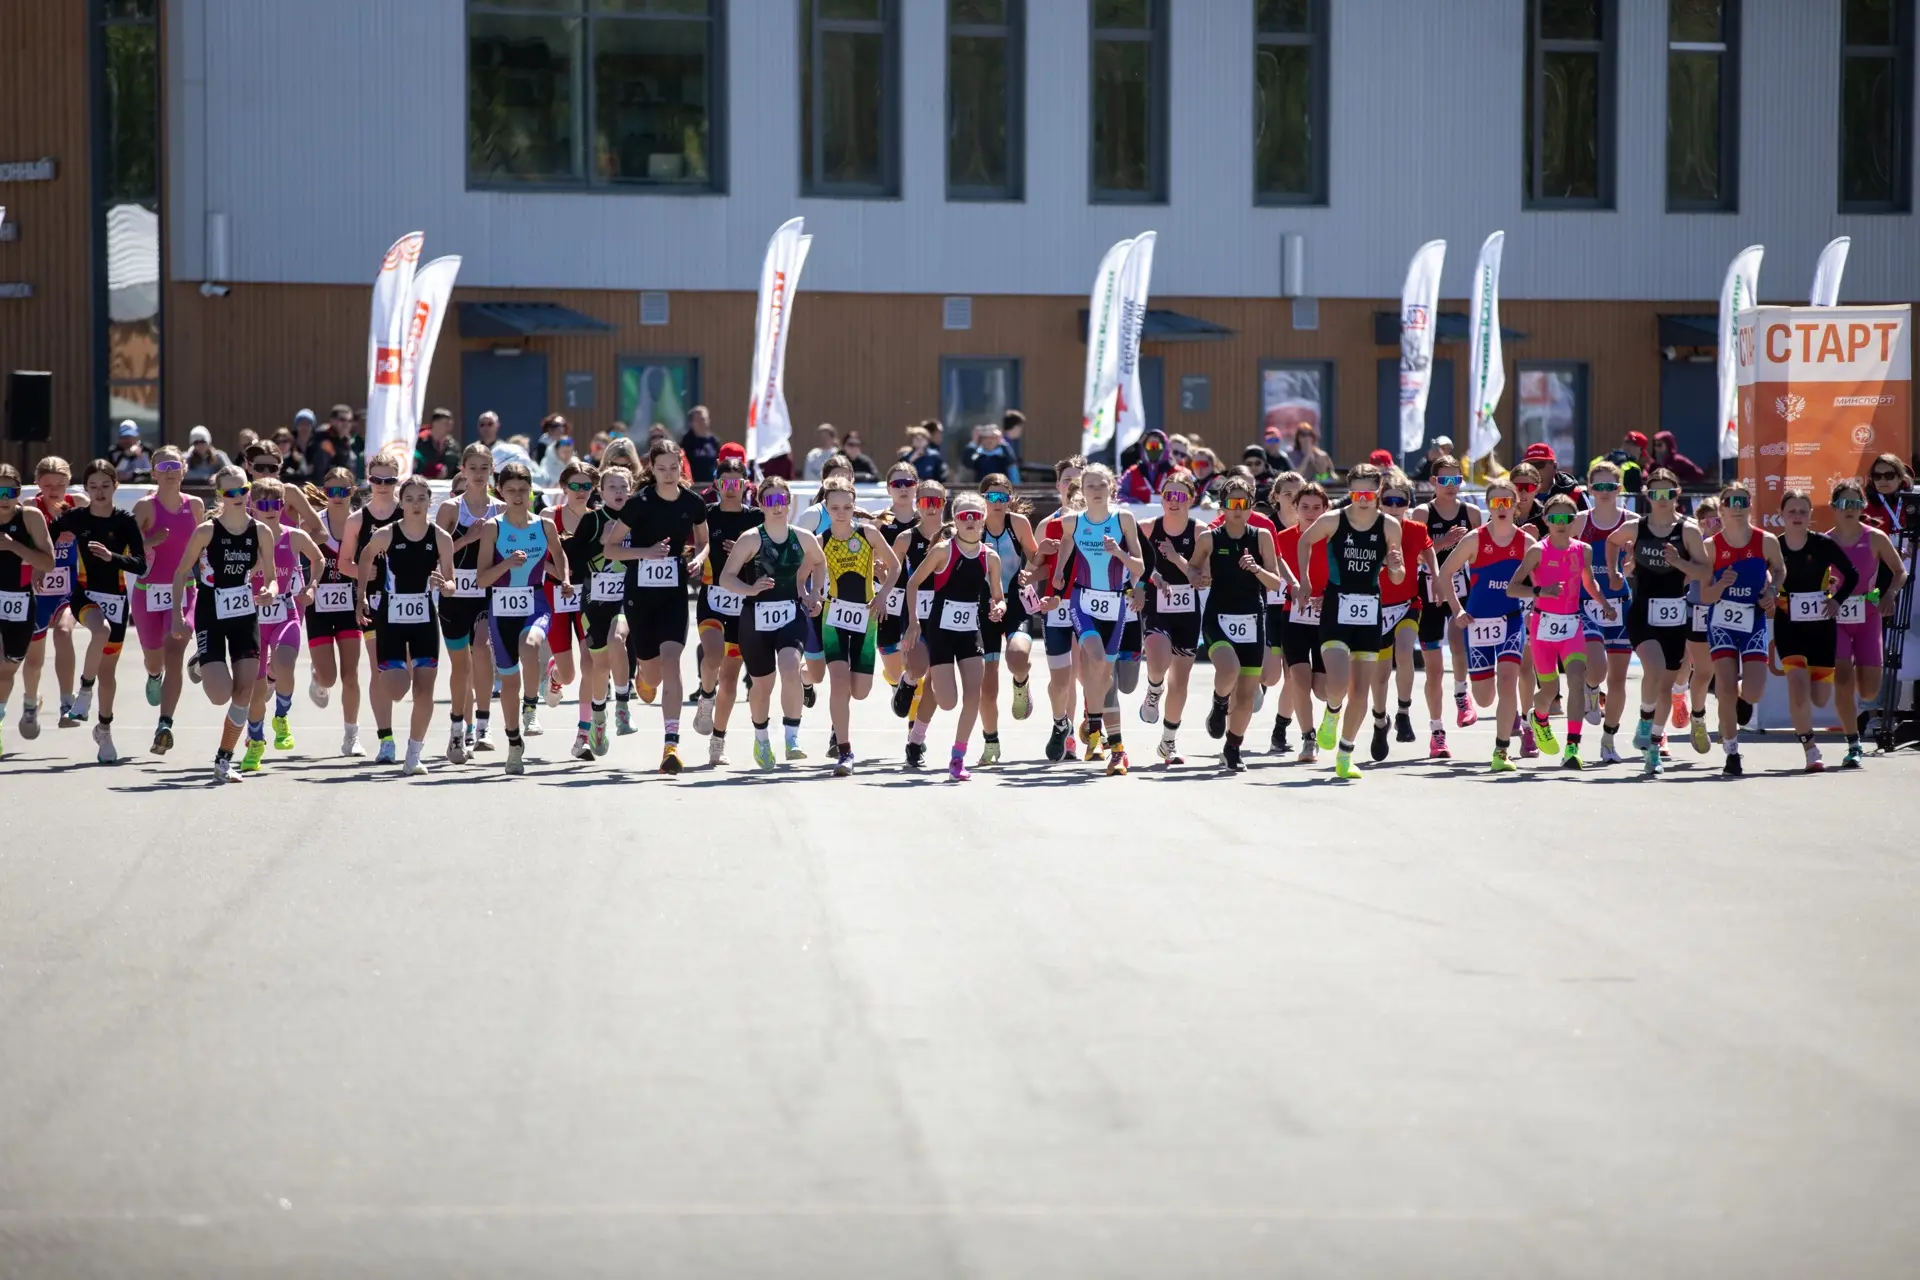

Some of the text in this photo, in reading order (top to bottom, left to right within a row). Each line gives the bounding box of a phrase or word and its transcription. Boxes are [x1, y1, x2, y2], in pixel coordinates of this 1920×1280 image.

[1766, 323, 1898, 364] СТАРТ
[1835, 396, 1893, 405] МИНСПОРТ
[55, 549, 69, 559] US
[1344, 548, 1377, 561] KIRILLOVA
[224, 563, 245, 575] RUS
[646, 566, 673, 580] 102
[1348, 560, 1371, 573] RUS
[46, 576, 65, 589] 29
[455, 577, 478, 591] 104
[599, 581, 625, 594] 122
[1488, 580, 1508, 590] RUS
[153, 592, 172, 605] 13
[322, 592, 347, 605] 126
[1729, 587, 1752, 597] RUS
[223, 594, 250, 611] 128
[500, 596, 528, 609] 103
[714, 595, 739, 609] 121
[1090, 599, 1109, 613] 98
[1166, 593, 1190, 606] 136
[1, 601, 22, 614] 08
[100, 602, 117, 616] 39
[396, 602, 424, 616] 106
[1350, 604, 1368, 618] 95
[1592, 608, 1606, 620] 11
[1660, 606, 1678, 619] 93
[1801, 601, 1819, 614] 91
[1841, 604, 1858, 618] 31
[763, 609, 789, 624] 101
[836, 608, 862, 625] 100
[953, 611, 970, 624] 99
[1724, 609, 1743, 624] 92
[1229, 623, 1246, 636] 96
[1474, 626, 1501, 640] 113
[1550, 623, 1568, 635] 94
